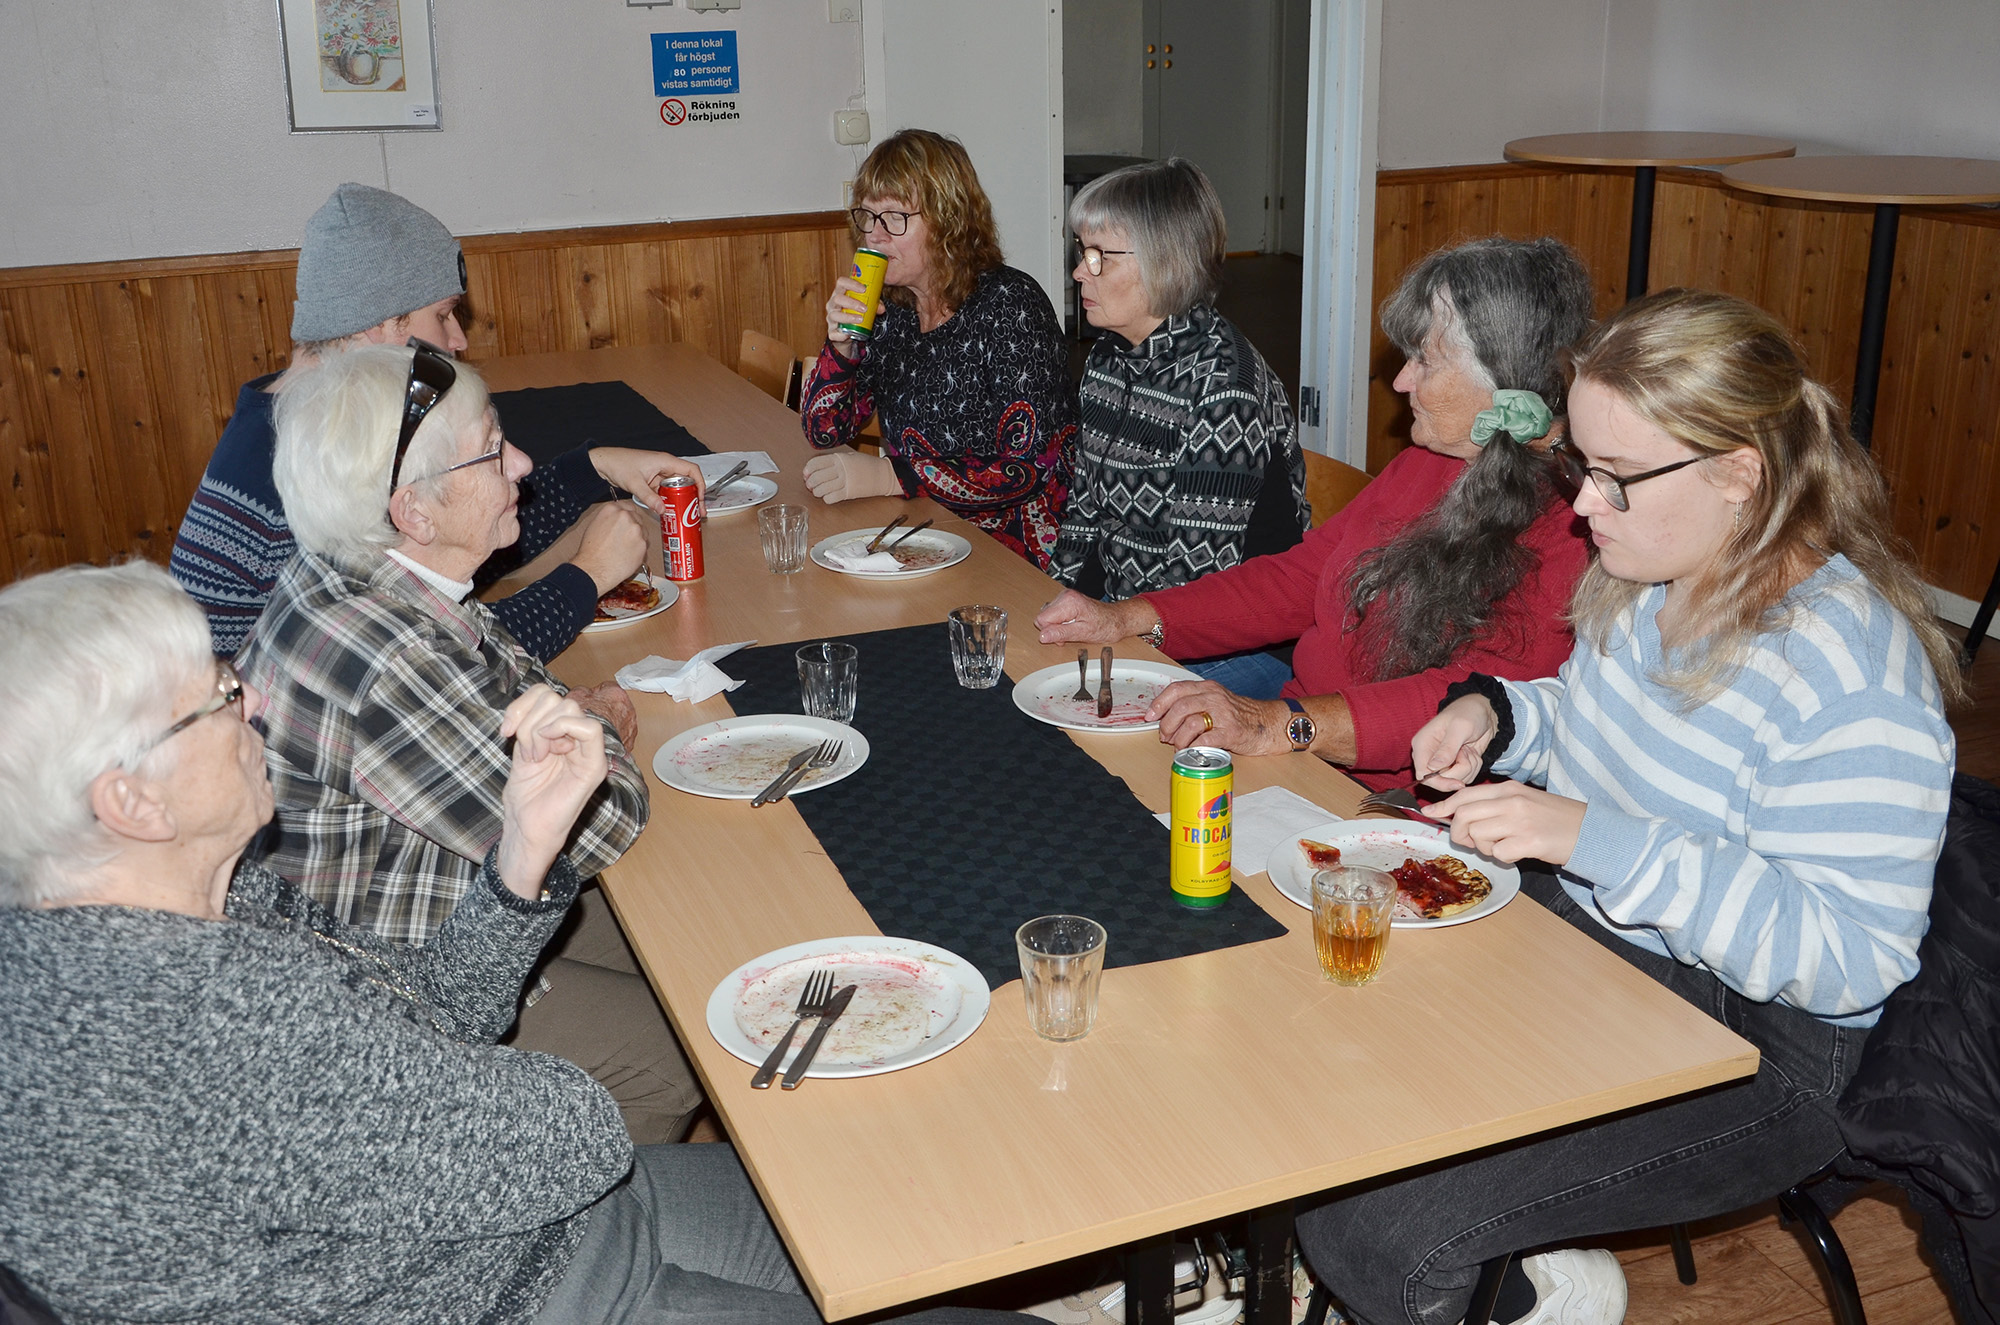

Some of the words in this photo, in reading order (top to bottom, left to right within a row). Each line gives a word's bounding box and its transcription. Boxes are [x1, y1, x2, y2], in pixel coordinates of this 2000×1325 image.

[665, 40, 669, 49] I
[671, 40, 699, 49] denna
[701, 38, 723, 48] lokal
[675, 52, 688, 62] får
[689, 52, 716, 63] högst
[673, 68, 686, 77] 80
[691, 66, 732, 76] personer
[661, 80, 688, 89] vistas
[690, 77, 732, 88] samtidigt
[691, 100, 736, 110] Rökning
[687, 111, 740, 122] förbjuden
